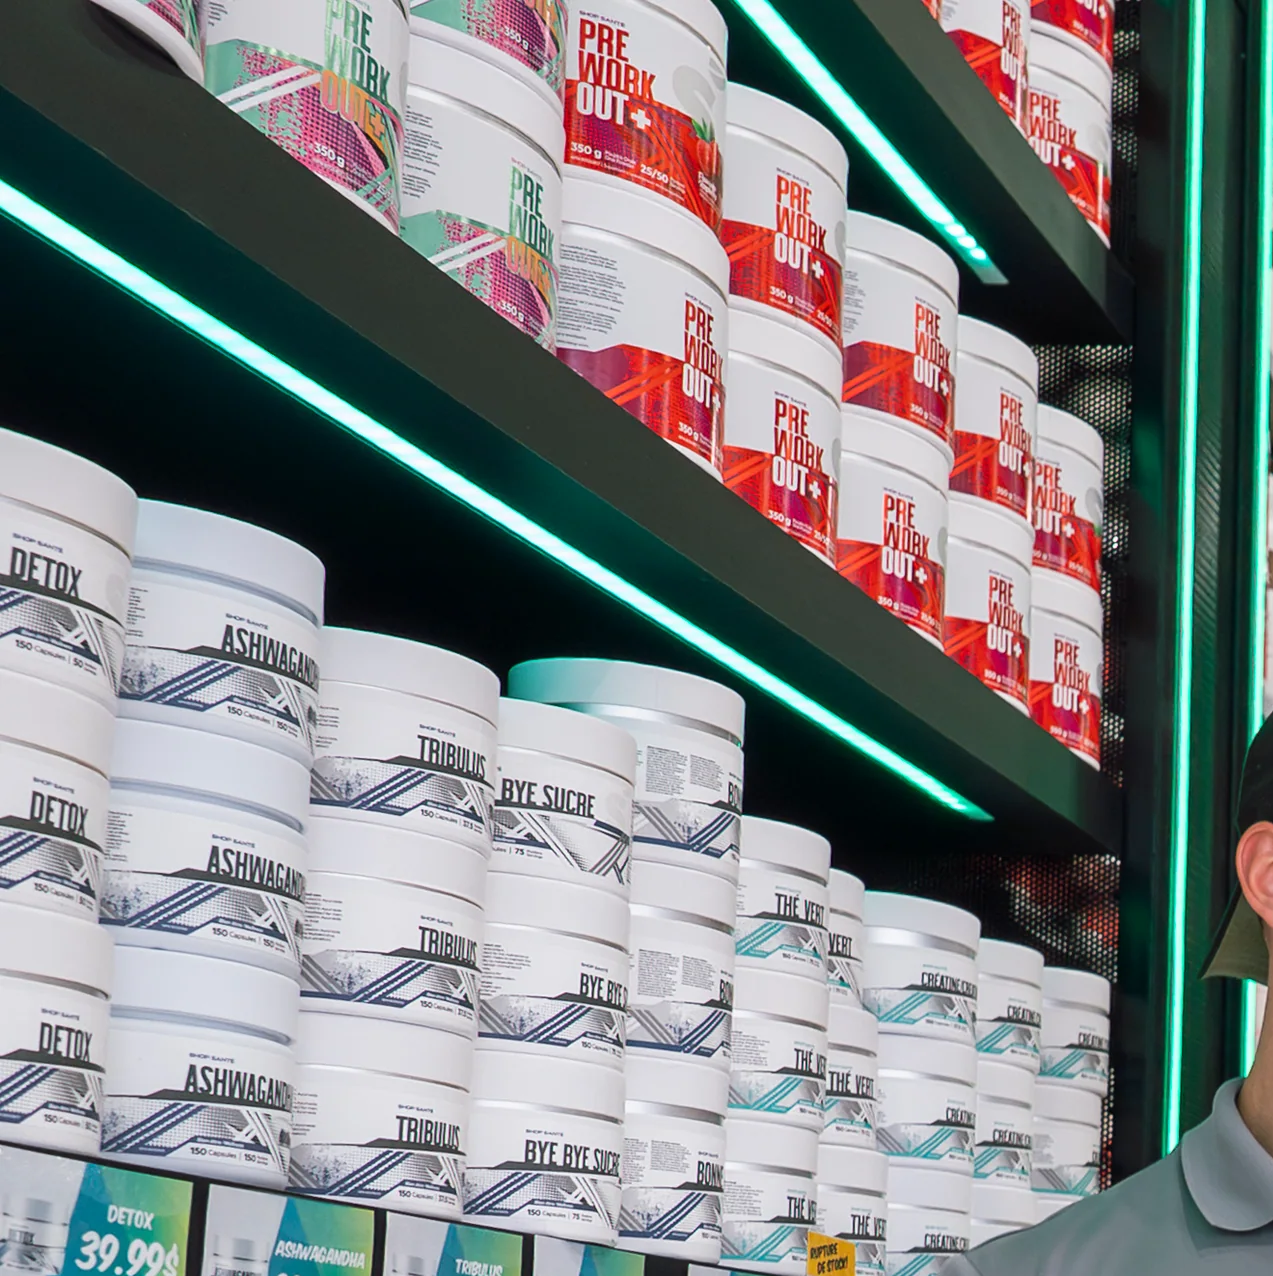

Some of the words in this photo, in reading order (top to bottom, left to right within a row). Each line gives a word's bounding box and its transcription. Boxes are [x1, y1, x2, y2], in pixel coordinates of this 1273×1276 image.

[326, 0, 373, 48] PRE
[504, 26, 523, 44] 350
[579, 18, 630, 62] PRE
[578, 50, 656, 102] WORK
[1030, 92, 1061, 122] PRE
[314, 142, 336, 160] 350
[571, 141, 592, 156] 350
[594, 148, 602, 159] g
[640, 164, 669, 184] 25/50
[511, 165, 545, 219] PRE
[776, 174, 812, 218] PRE
[776, 202, 828, 252] WORK
[770, 286, 787, 300] 350
[500, 301, 517, 318] 350
[685, 299, 715, 346] PRE
[915, 303, 941, 341] PRE
[678, 421, 693, 436] 350
[775, 398, 809, 439] PRE
[774, 426, 824, 473] WORK
[1035, 461, 1062, 489] PRE
[767, 510, 785, 524] 350
[884, 494, 916, 530] PRE
[883, 520, 930, 560] WORK
[10, 546, 82, 599] DETOX
[989, 575, 1014, 608] PRE
[15, 639, 33, 651] 150
[1054, 639, 1080, 668] PRE
[227, 705, 243, 717] 150
[417, 734, 486, 780] TRIBULUS
[502, 777, 537, 805] BYE
[542, 784, 596, 819] SUCRE
[30, 790, 89, 838] DETOX
[420, 808, 434, 818] 150
[775, 892, 800, 918] THÉ
[212, 927, 229, 938] 150
[418, 925, 478, 967] TRIBULUS
[828, 932, 852, 956] VERT
[580, 972, 604, 999] BYE
[40, 1022, 93, 1063] DETOX
[829, 1070, 851, 1094] THÉ
[396, 1114, 460, 1153] TRIBULUS
[190, 1147, 207, 1156] 150
[525, 1138, 558, 1167] BYE
[563, 1143, 590, 1169] BYE
[398, 1189, 412, 1199] 150
[107, 1204, 154, 1231] DETOX
[527, 1208, 541, 1217] 150
[275, 1240, 366, 1270] ASHWAGANDHA
[810, 1242, 838, 1260] RUPTURE
[817, 1262, 825, 1275] DE
